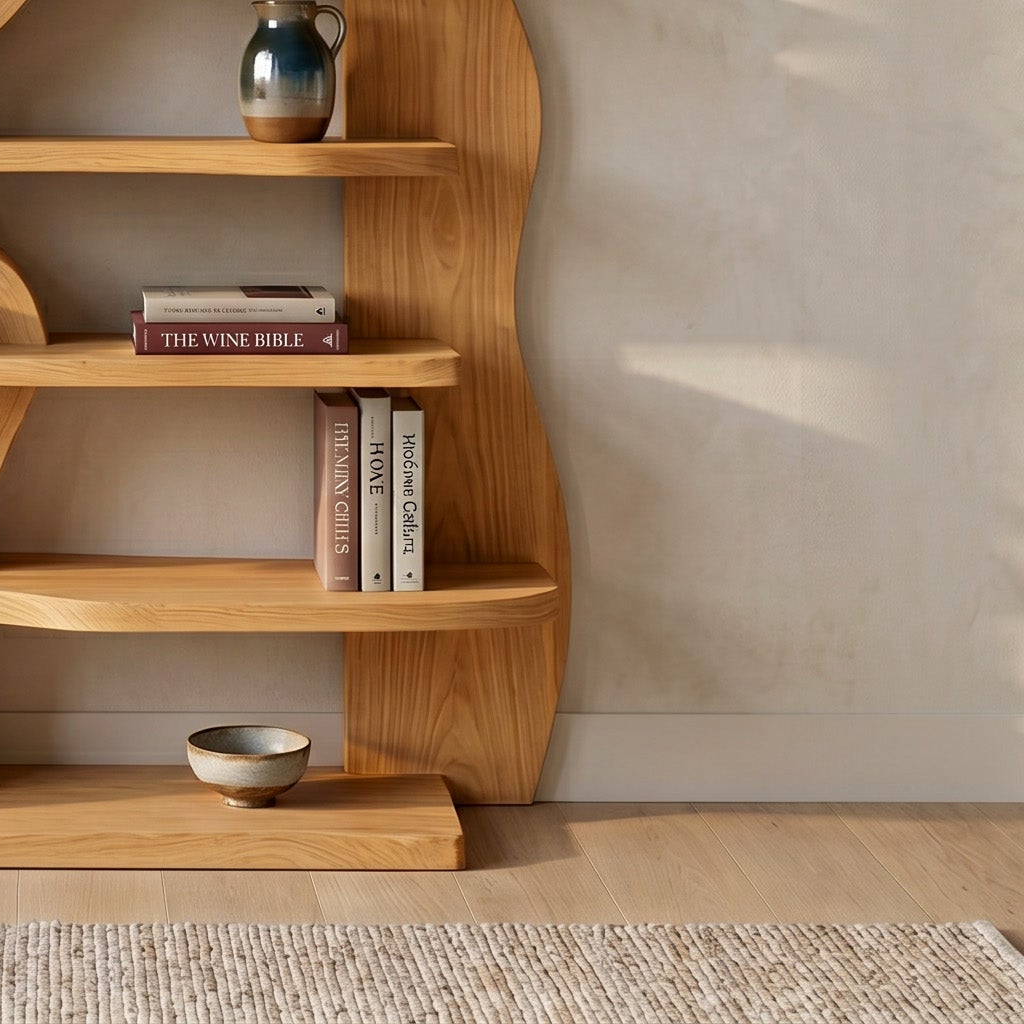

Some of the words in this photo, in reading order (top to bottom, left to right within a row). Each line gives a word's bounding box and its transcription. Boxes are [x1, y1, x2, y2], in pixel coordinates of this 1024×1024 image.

[161, 333, 199, 348] THE
[203, 333, 250, 348] WINE
[254, 333, 305, 348] BIBLE
